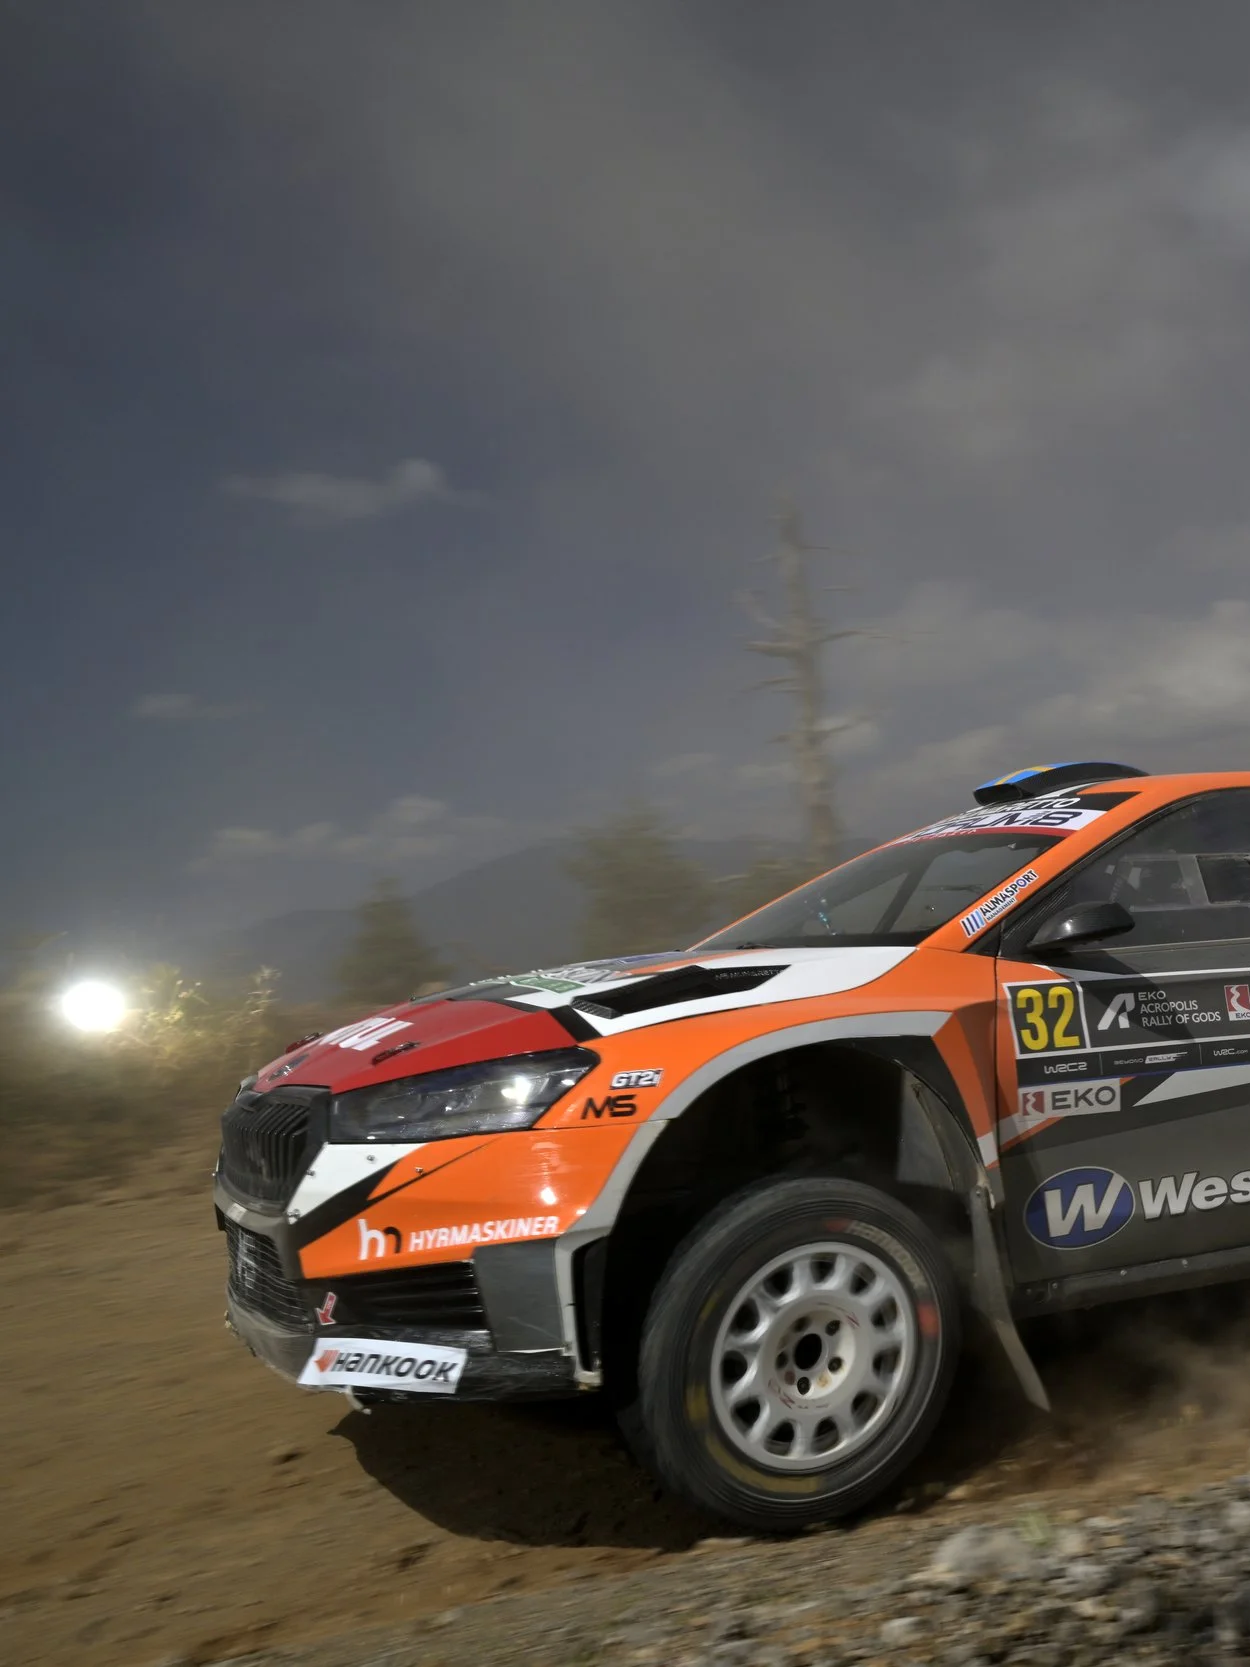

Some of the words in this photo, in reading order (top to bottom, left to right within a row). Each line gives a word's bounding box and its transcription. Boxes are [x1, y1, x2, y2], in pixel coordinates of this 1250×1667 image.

[979, 869, 1038, 917] ALMASPORT
[986, 898, 1016, 920] MANAGEMENT
[1139, 990, 1166, 1001] EKO
[1140, 1000, 1198, 1014] ACROPOLIS
[1016, 986, 1081, 1051] 32
[1142, 1014, 1172, 1027] RALLY
[1176, 1012, 1190, 1024] OF
[1191, 1011, 1221, 1023] GODS
[1044, 1061, 1087, 1074] WRC2
[1113, 1057, 1144, 1066] BEYOND
[1147, 1054, 1173, 1063] RALLY
[581, 1094, 637, 1120] MS
[1051, 1085, 1116, 1111] EKO
[409, 1215, 560, 1252] HYRMASKINER
